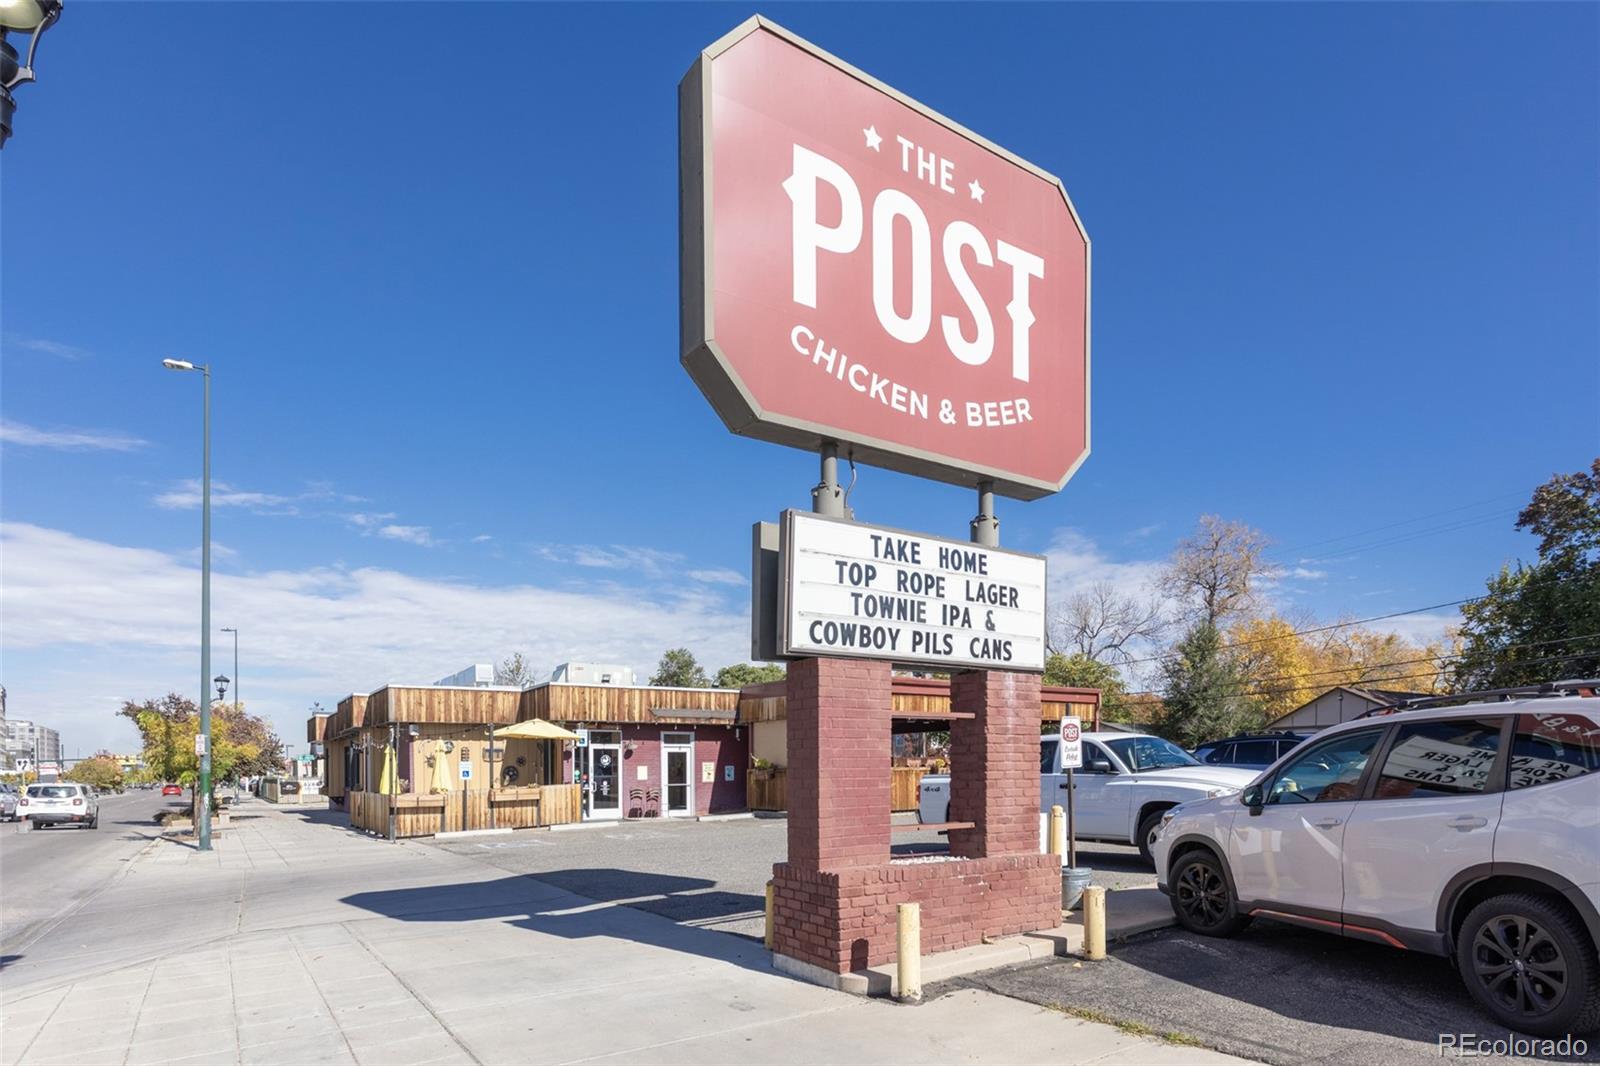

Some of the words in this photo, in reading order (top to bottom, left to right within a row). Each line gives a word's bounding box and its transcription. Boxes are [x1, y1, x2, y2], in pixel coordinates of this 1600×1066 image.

[896, 134, 955, 194] THE
[781, 143, 1045, 383] POST
[790, 325, 928, 419] CHICKEN
[938, 399, 956, 424] &
[965, 398, 1033, 427] BEER
[870, 534, 921, 564] TAKE
[939, 546, 988, 575] HOME
[835, 560, 877, 587] TOP
[896, 569, 945, 598] ROPE
[965, 579, 1019, 608] LAGER
[850, 592, 926, 623] TOWNIE
[942, 604, 972, 628] IPA
[985, 610, 996, 631] &
[809, 620, 900, 651] COWBOY
[912, 630, 953, 655] PILS
[970, 637, 1012, 661] CANS
